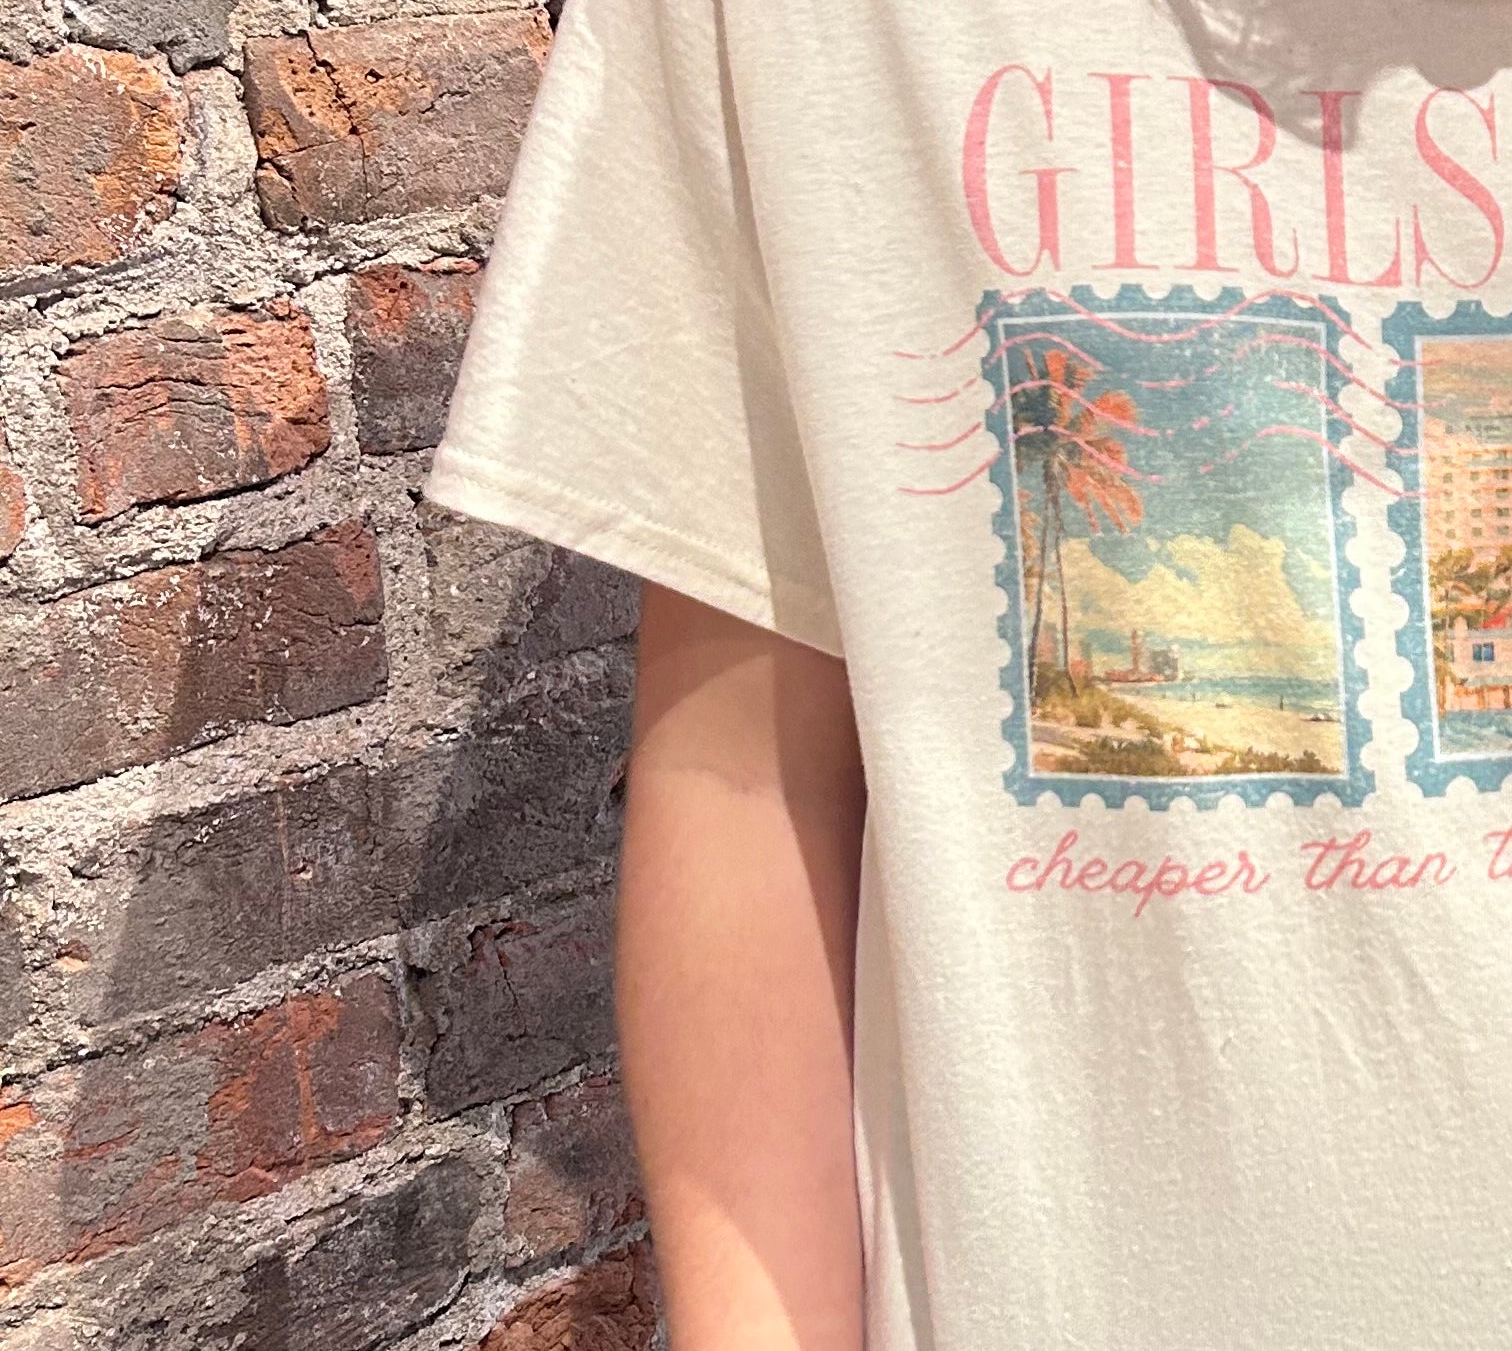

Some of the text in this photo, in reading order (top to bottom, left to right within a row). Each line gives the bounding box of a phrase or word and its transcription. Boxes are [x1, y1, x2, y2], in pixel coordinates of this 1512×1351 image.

[962, 63, 1505, 290] GIRLS
[1005, 829, 1271, 918] cheaper
[1300, 828, 1457, 891] than
